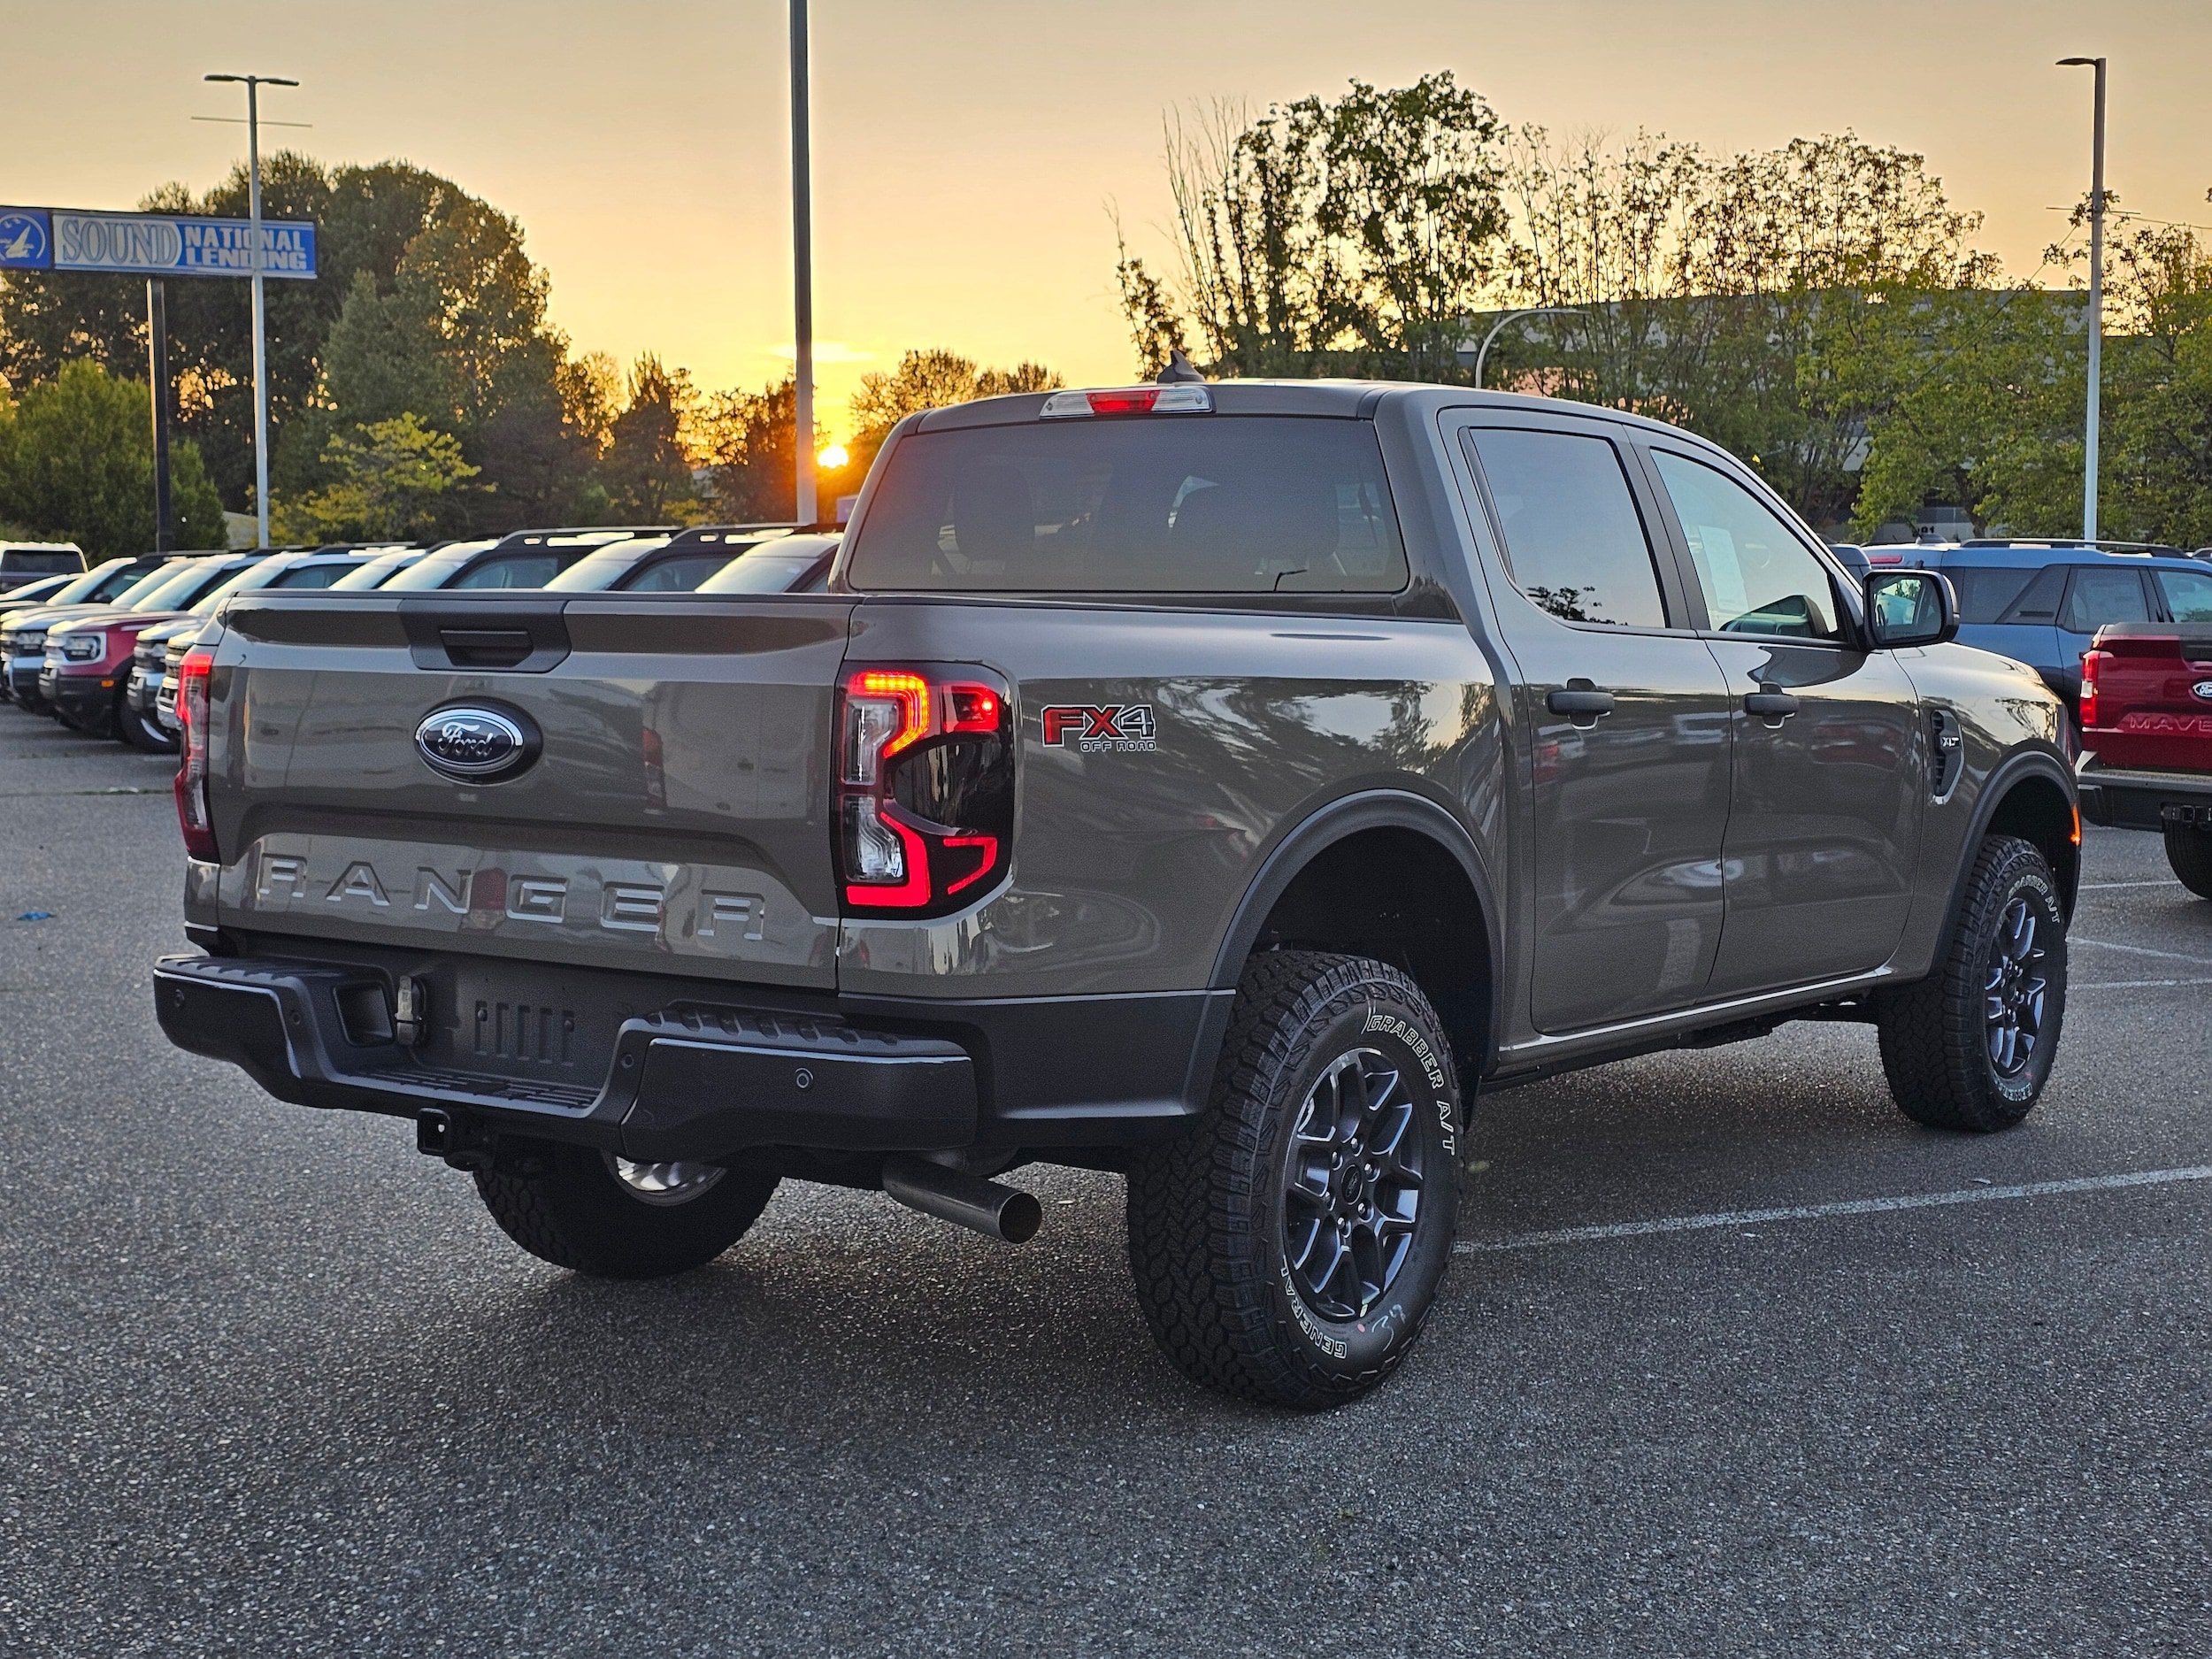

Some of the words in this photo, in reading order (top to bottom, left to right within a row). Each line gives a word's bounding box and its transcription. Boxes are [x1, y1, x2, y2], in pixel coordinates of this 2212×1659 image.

[62, 219, 179, 265] SOUND
[437, 721, 494, 757] Ford
[1041, 704, 1156, 748] FX4
[1080, 741, 1112, 752] OFF
[1117, 740, 1156, 752] ROAD
[256, 853, 766, 941] RANGER
[1366, 1015, 1445, 1090] GRABBER
[1436, 1100, 1456, 1156] A/T
[1280, 1255, 1348, 1359] GENERAL
